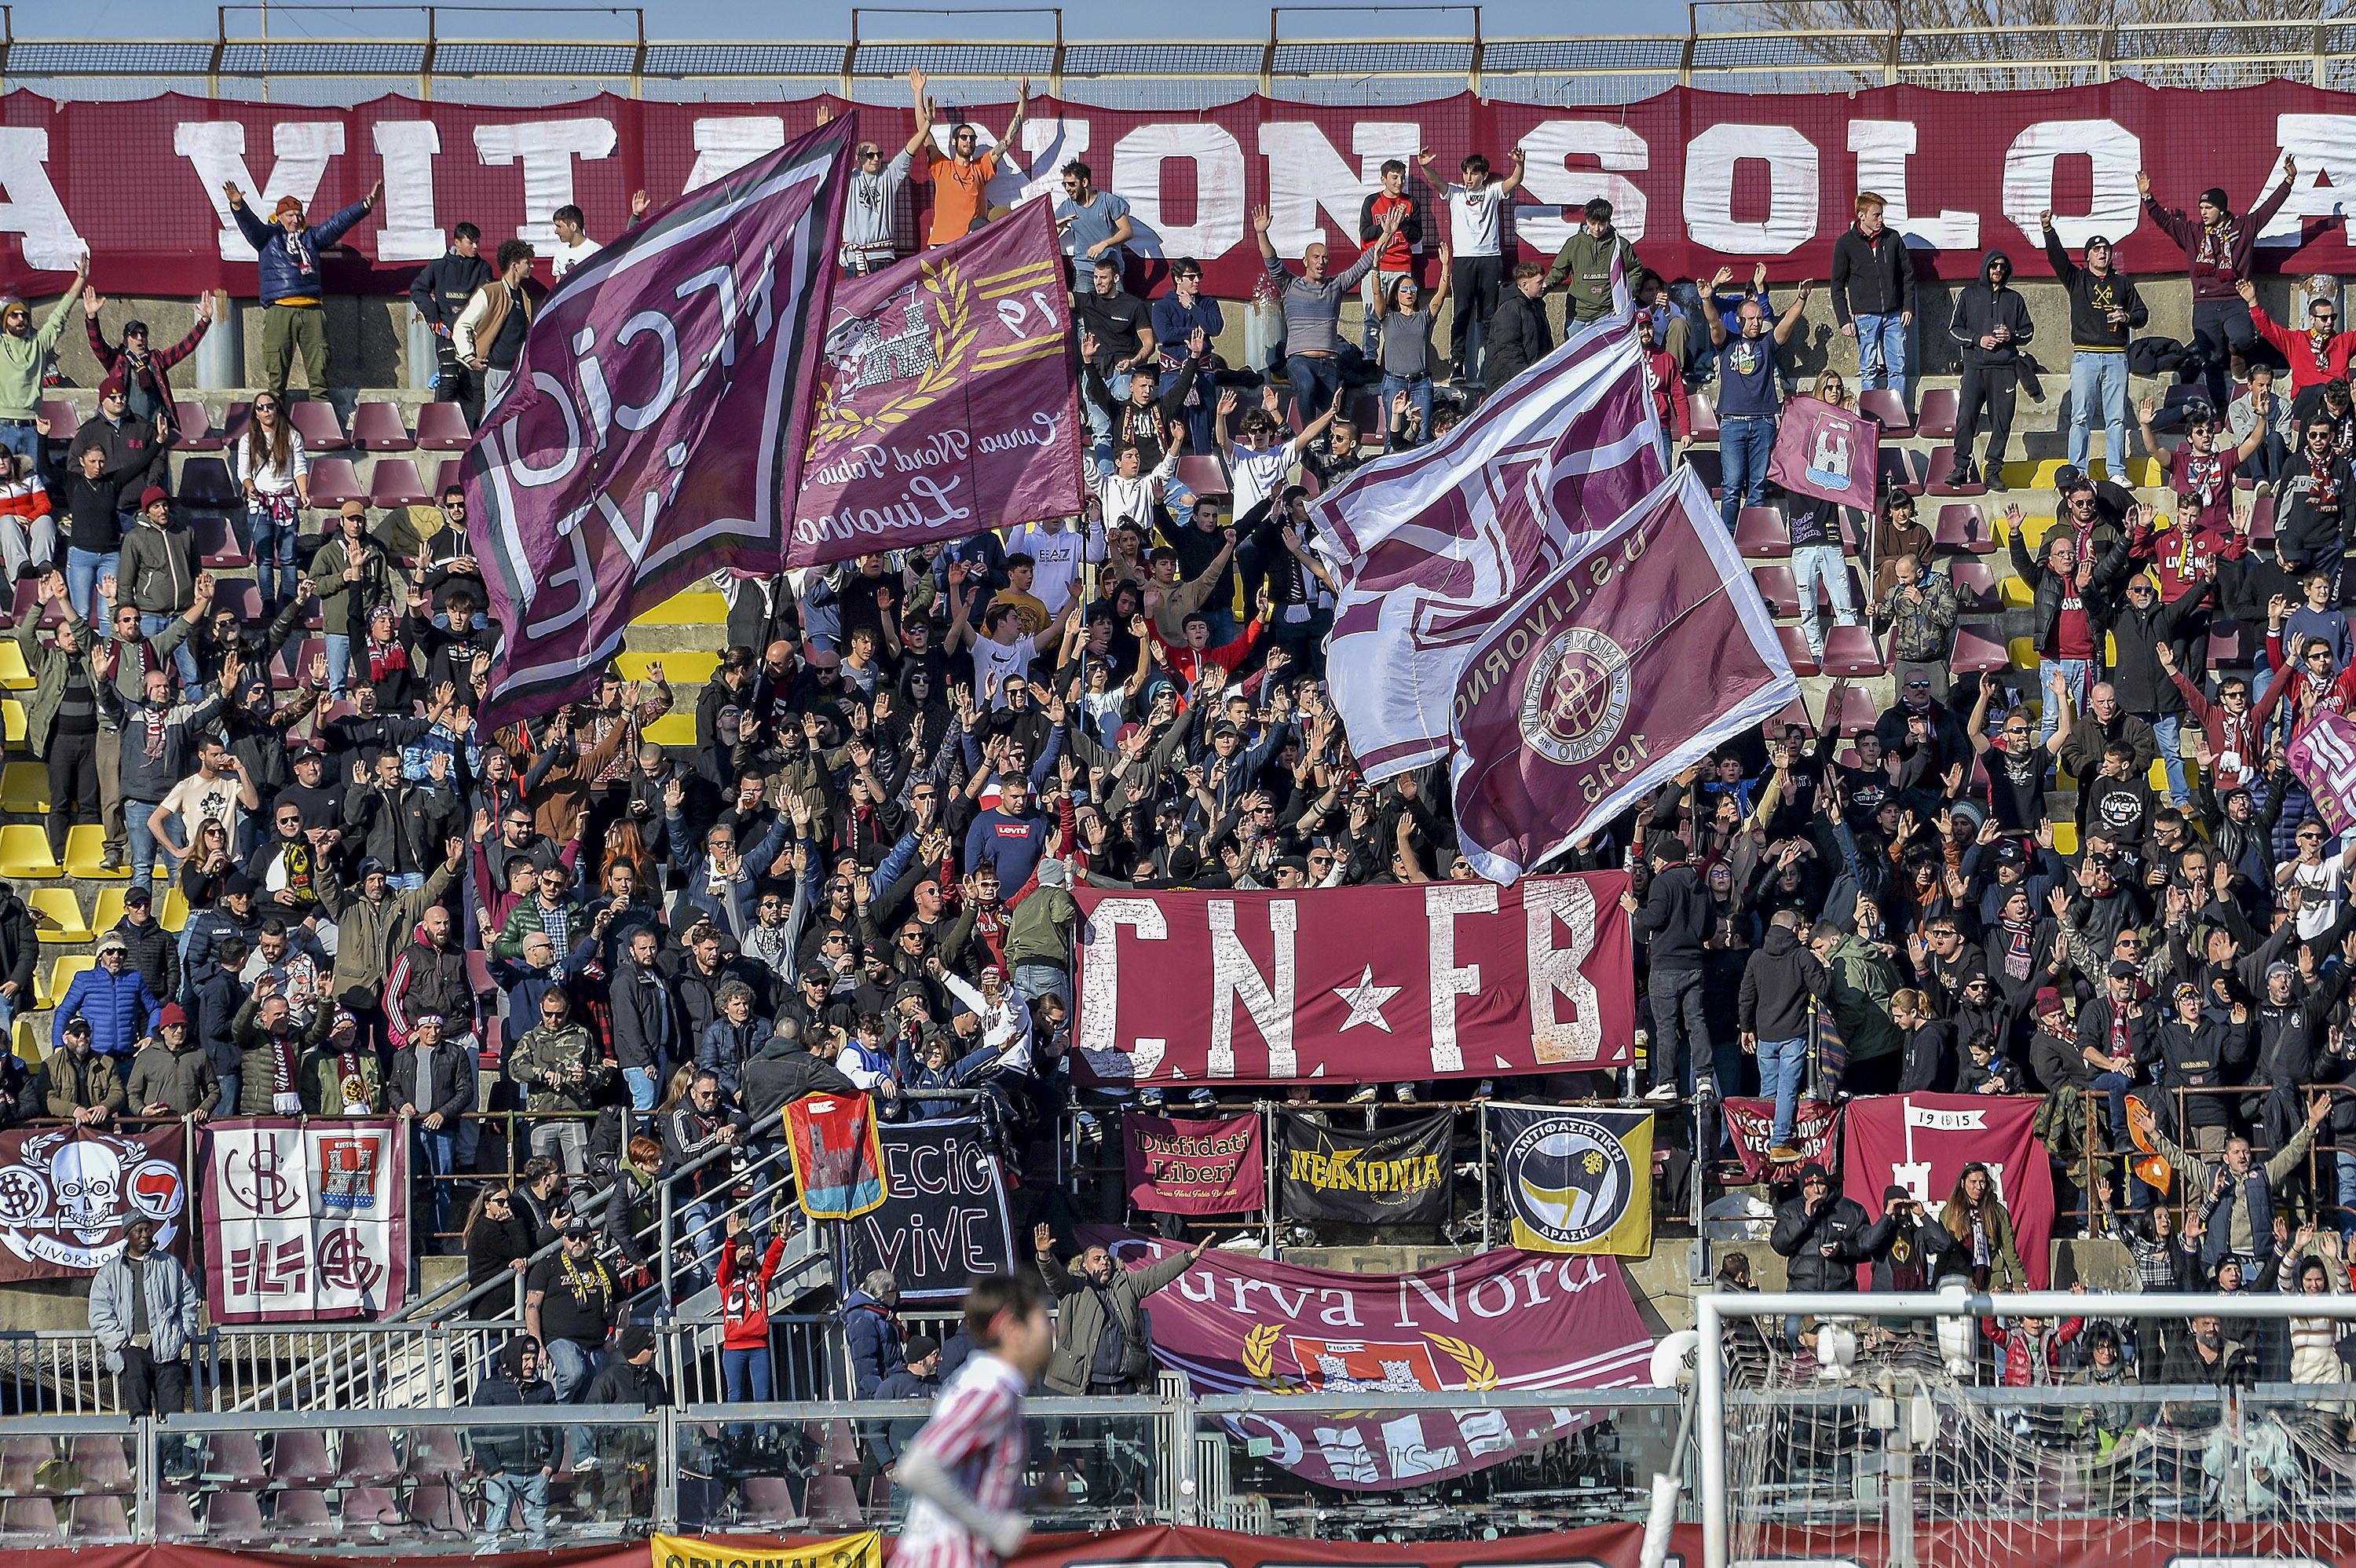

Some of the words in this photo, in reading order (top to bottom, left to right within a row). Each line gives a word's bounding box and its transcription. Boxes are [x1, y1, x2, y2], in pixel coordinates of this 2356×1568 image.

[1516, 119, 2142, 256] SOLO
[2165, 556, 2208, 568] LIVN
[2105, 801, 2137, 813] NASA
[1919, 1111, 1934, 1125] 19
[1955, 1114, 1970, 1128] 15
[1134, 1129, 1251, 1157] Diffidati
[1513, 1121, 1625, 1162] ΑΝΤΙΦΑΣΙΣΤΙΚΗ
[1152, 1158, 1237, 1184] Liberi
[1173, 1189, 1192, 1197] Nord
[1192, 1189, 1210, 1198] Fabio
[1539, 1225, 1591, 1241] ΔΡΑΣΗ
[34, 1239, 112, 1265] LIVORNO
[1394, 1253, 1608, 1329] Nord
